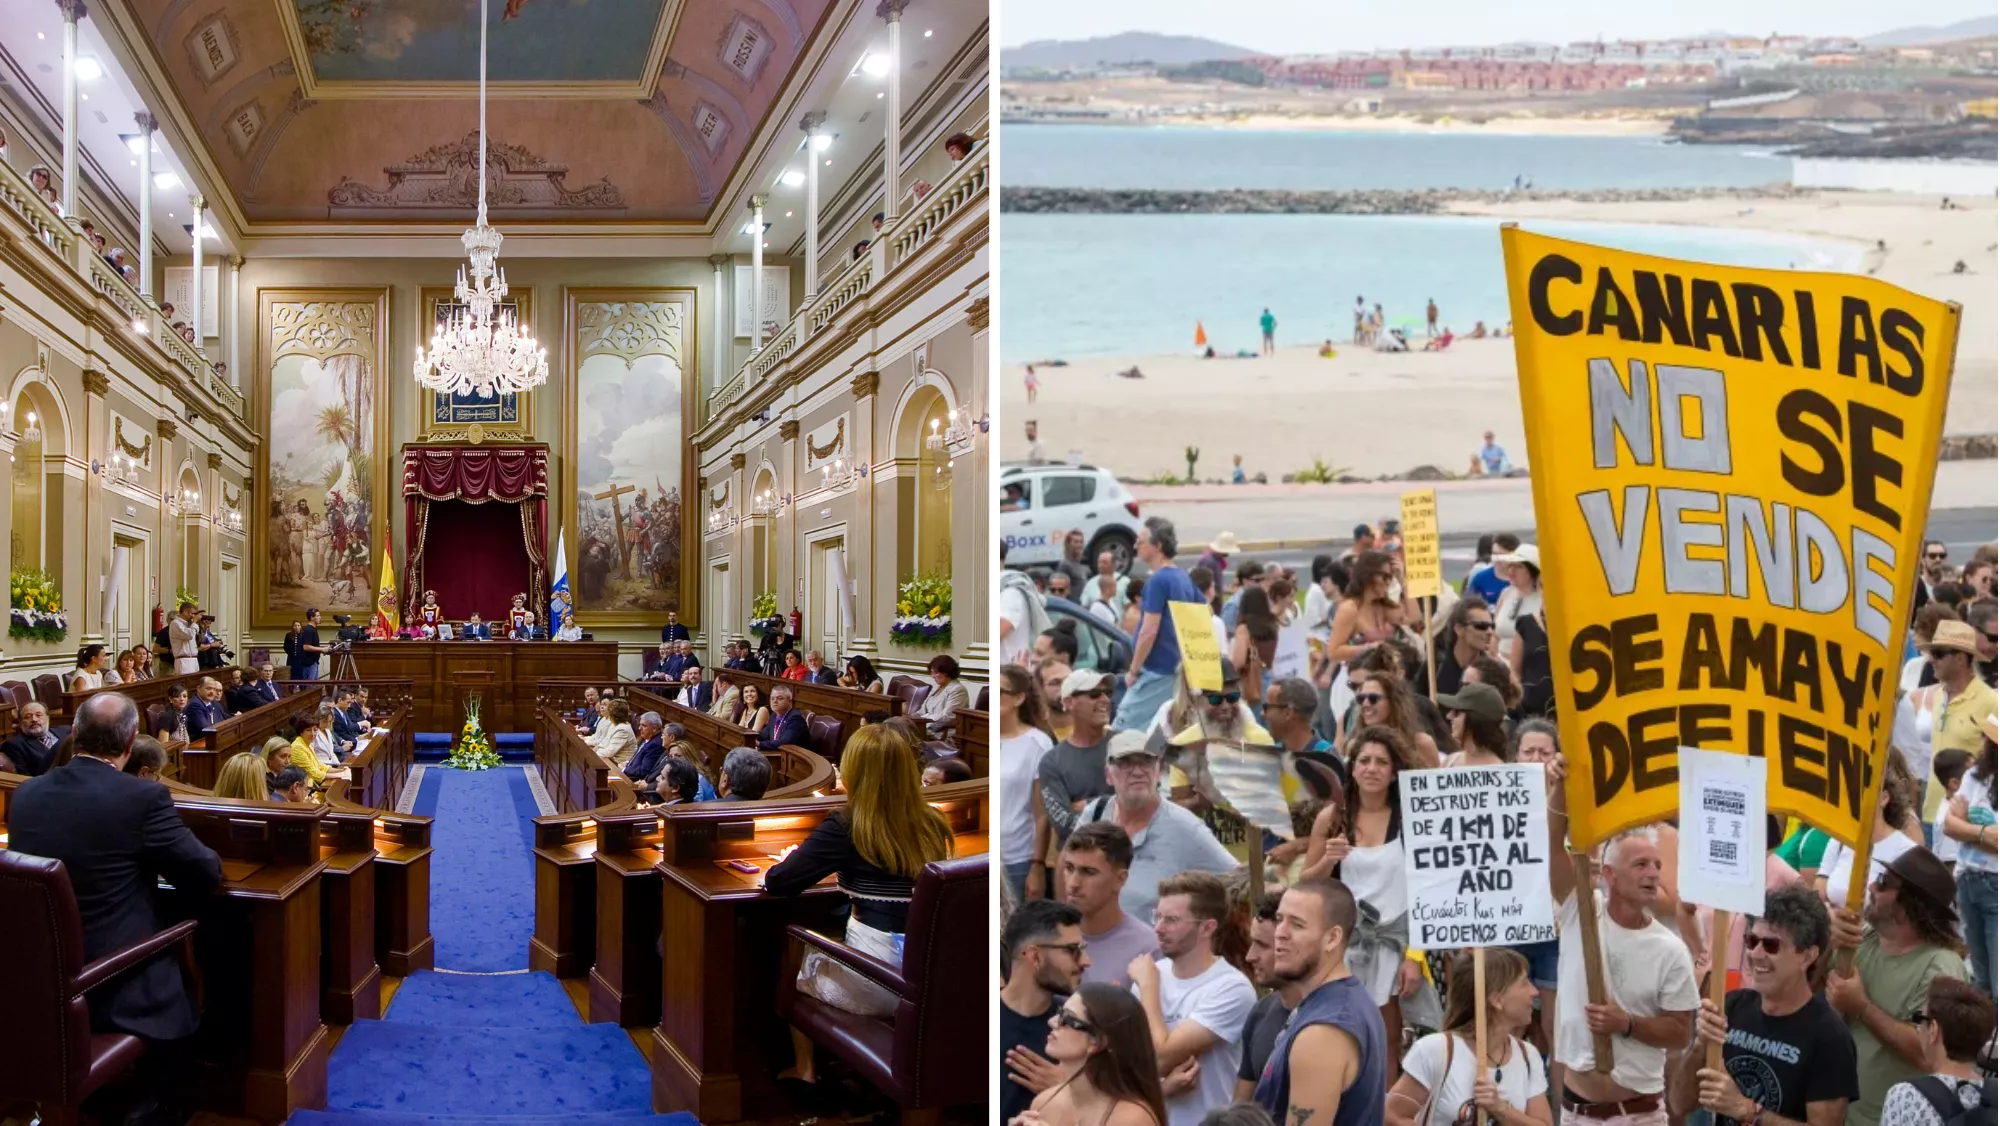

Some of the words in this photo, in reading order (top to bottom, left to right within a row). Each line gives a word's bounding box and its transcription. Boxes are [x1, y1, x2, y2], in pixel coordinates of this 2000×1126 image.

[200, 27, 225, 71] HAENDEL
[732, 28, 759, 71] ROSSINI
[237, 112, 255, 138] BACH
[1529, 254, 1925, 397] CANARIAS
[1587, 357, 1733, 475] NO
[1776, 388, 1904, 533] SE
[1576, 485, 1896, 650] VENDE
[1570, 613, 1665, 712] SE
[1410, 776, 1428, 791] EN
[1436, 771, 1503, 790] CANARIAS
[1505, 770, 1525, 788] SE
[1410, 792, 1489, 813] DESTRUYE
[1497, 789, 1531, 807] MÁS
[1412, 819, 1434, 836] DE
[1439, 817, 1453, 842] 4
[1460, 813, 1494, 841] KM
[1502, 812, 1528, 840] DE
[1413, 842, 1499, 870] COSTA
[1507, 842, 1543, 866] AL
[1457, 865, 1514, 895] AÑO
[1421, 923, 1498, 944] PODEMOS
[1505, 924, 1555, 942] QUEMAR
